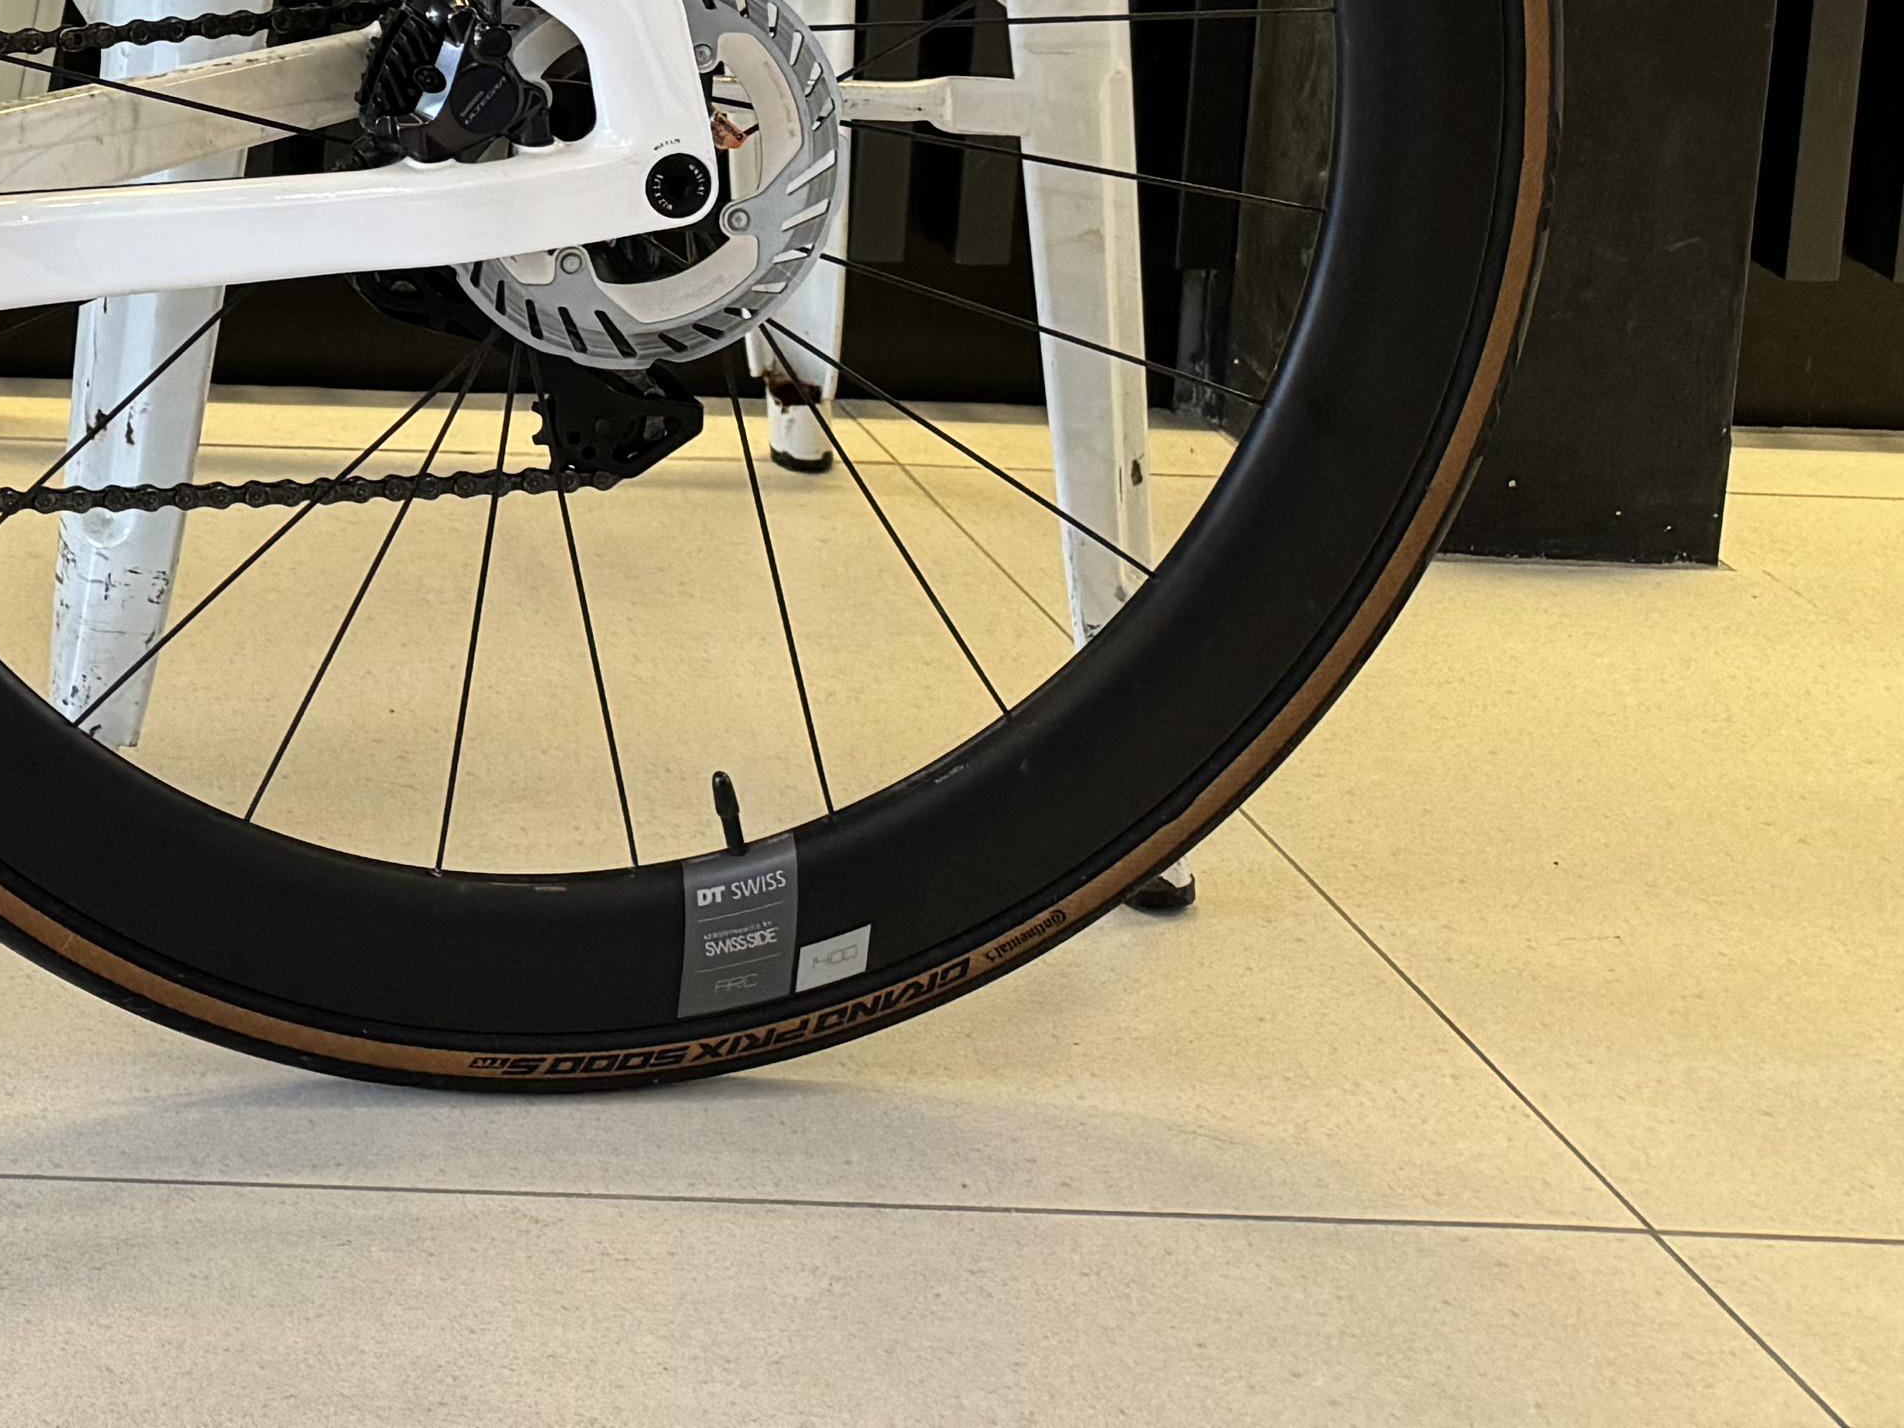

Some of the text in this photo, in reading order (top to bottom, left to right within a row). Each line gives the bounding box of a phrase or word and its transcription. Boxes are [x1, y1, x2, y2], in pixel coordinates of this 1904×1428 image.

[696, 870, 787, 907] DT SWISS
[993, 908, 1067, 960] Continental
[812, 958, 971, 1037] GRAND
[546, 1048, 688, 1076] 5000
[689, 1024, 814, 1066] PRIX
